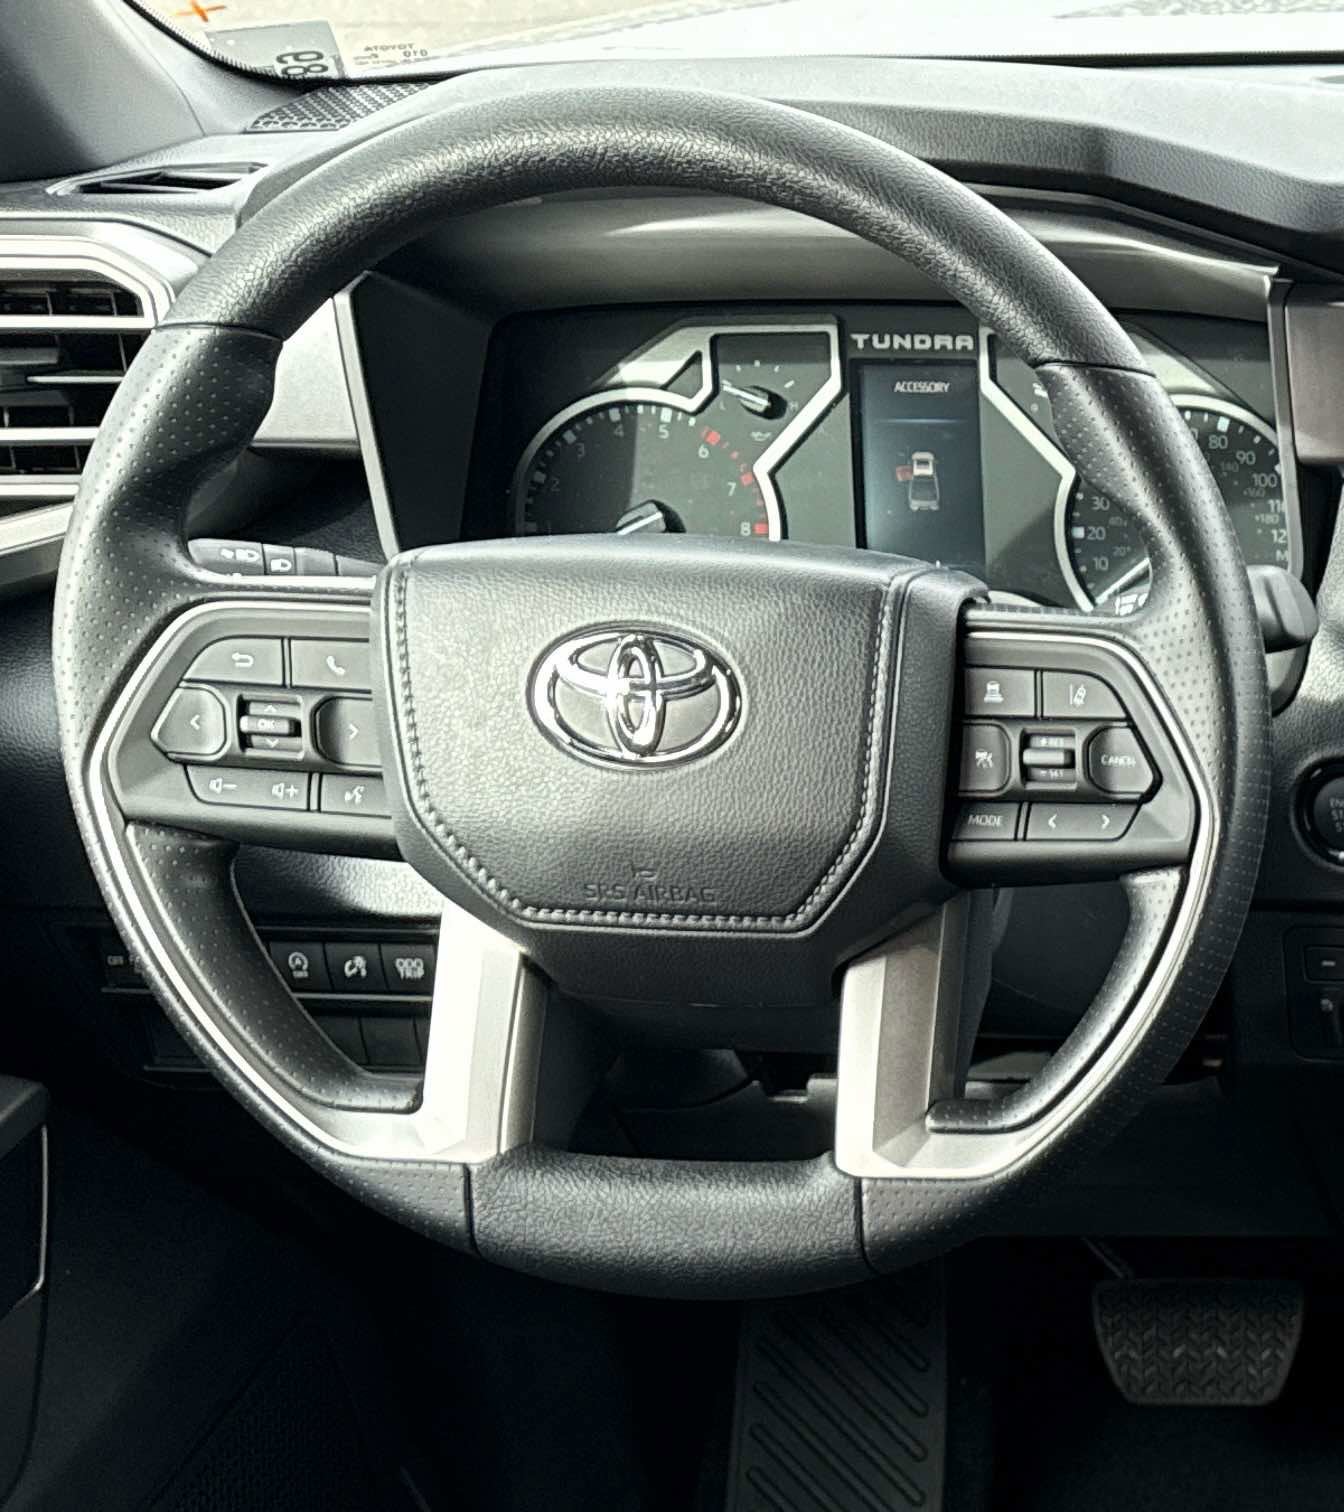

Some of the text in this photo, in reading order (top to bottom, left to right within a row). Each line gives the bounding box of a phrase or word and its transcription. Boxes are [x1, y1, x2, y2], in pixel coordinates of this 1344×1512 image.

[850, 333, 975, 350] TUNDRA
[893, 381, 950, 393] ACCESSORY
[658, 424, 670, 440] 5
[1208, 434, 1229, 450] 80
[698, 444, 709, 459] 6
[1235, 451, 1256, 466] 90
[1252, 473, 1278, 488] 100
[727, 482, 738, 497] 7
[1091, 496, 1110, 511] 30
[1268, 499, 1286, 513] 11
[740, 521, 752, 537] 8
[1086, 526, 1107, 541] 20
[1093, 557, 1109, 571] 10
[967, 815, 1002, 827] MODE
[394, 957, 424, 969] ODO
[397, 967, 425, 979] TRIP
